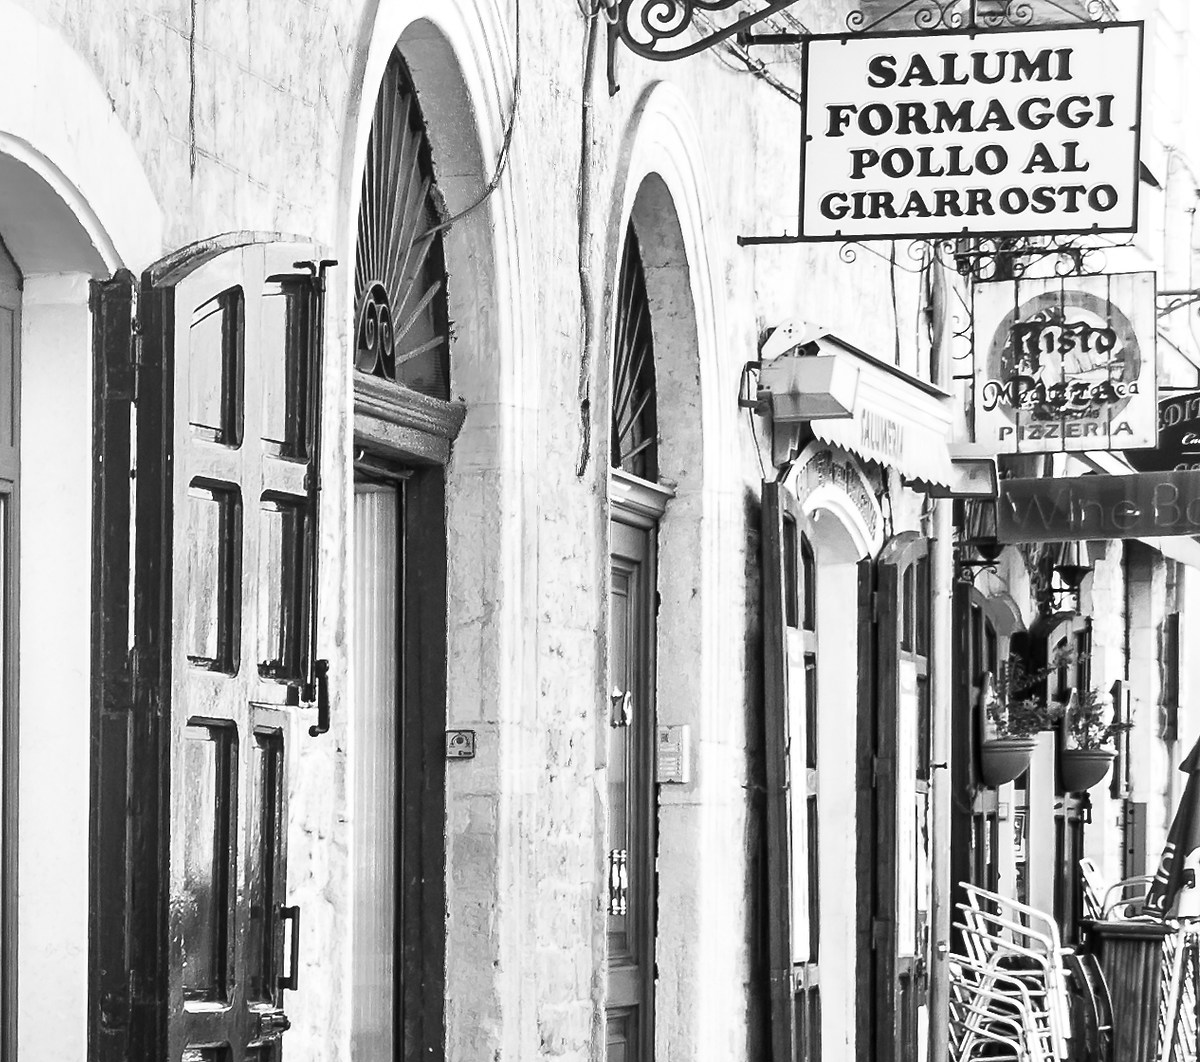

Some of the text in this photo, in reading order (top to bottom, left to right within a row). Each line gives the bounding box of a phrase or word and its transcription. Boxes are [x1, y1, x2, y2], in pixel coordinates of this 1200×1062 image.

[867, 48, 1074, 89] SALUMI
[825, 94, 1116, 137] FORMAGGI
[849, 141, 1090, 180] POLLO AL
[819, 184, 1119, 220] GIRARROSTO
[998, 421, 1135, 441] PIZZERIA
[1006, 487, 1142, 531] Wine
